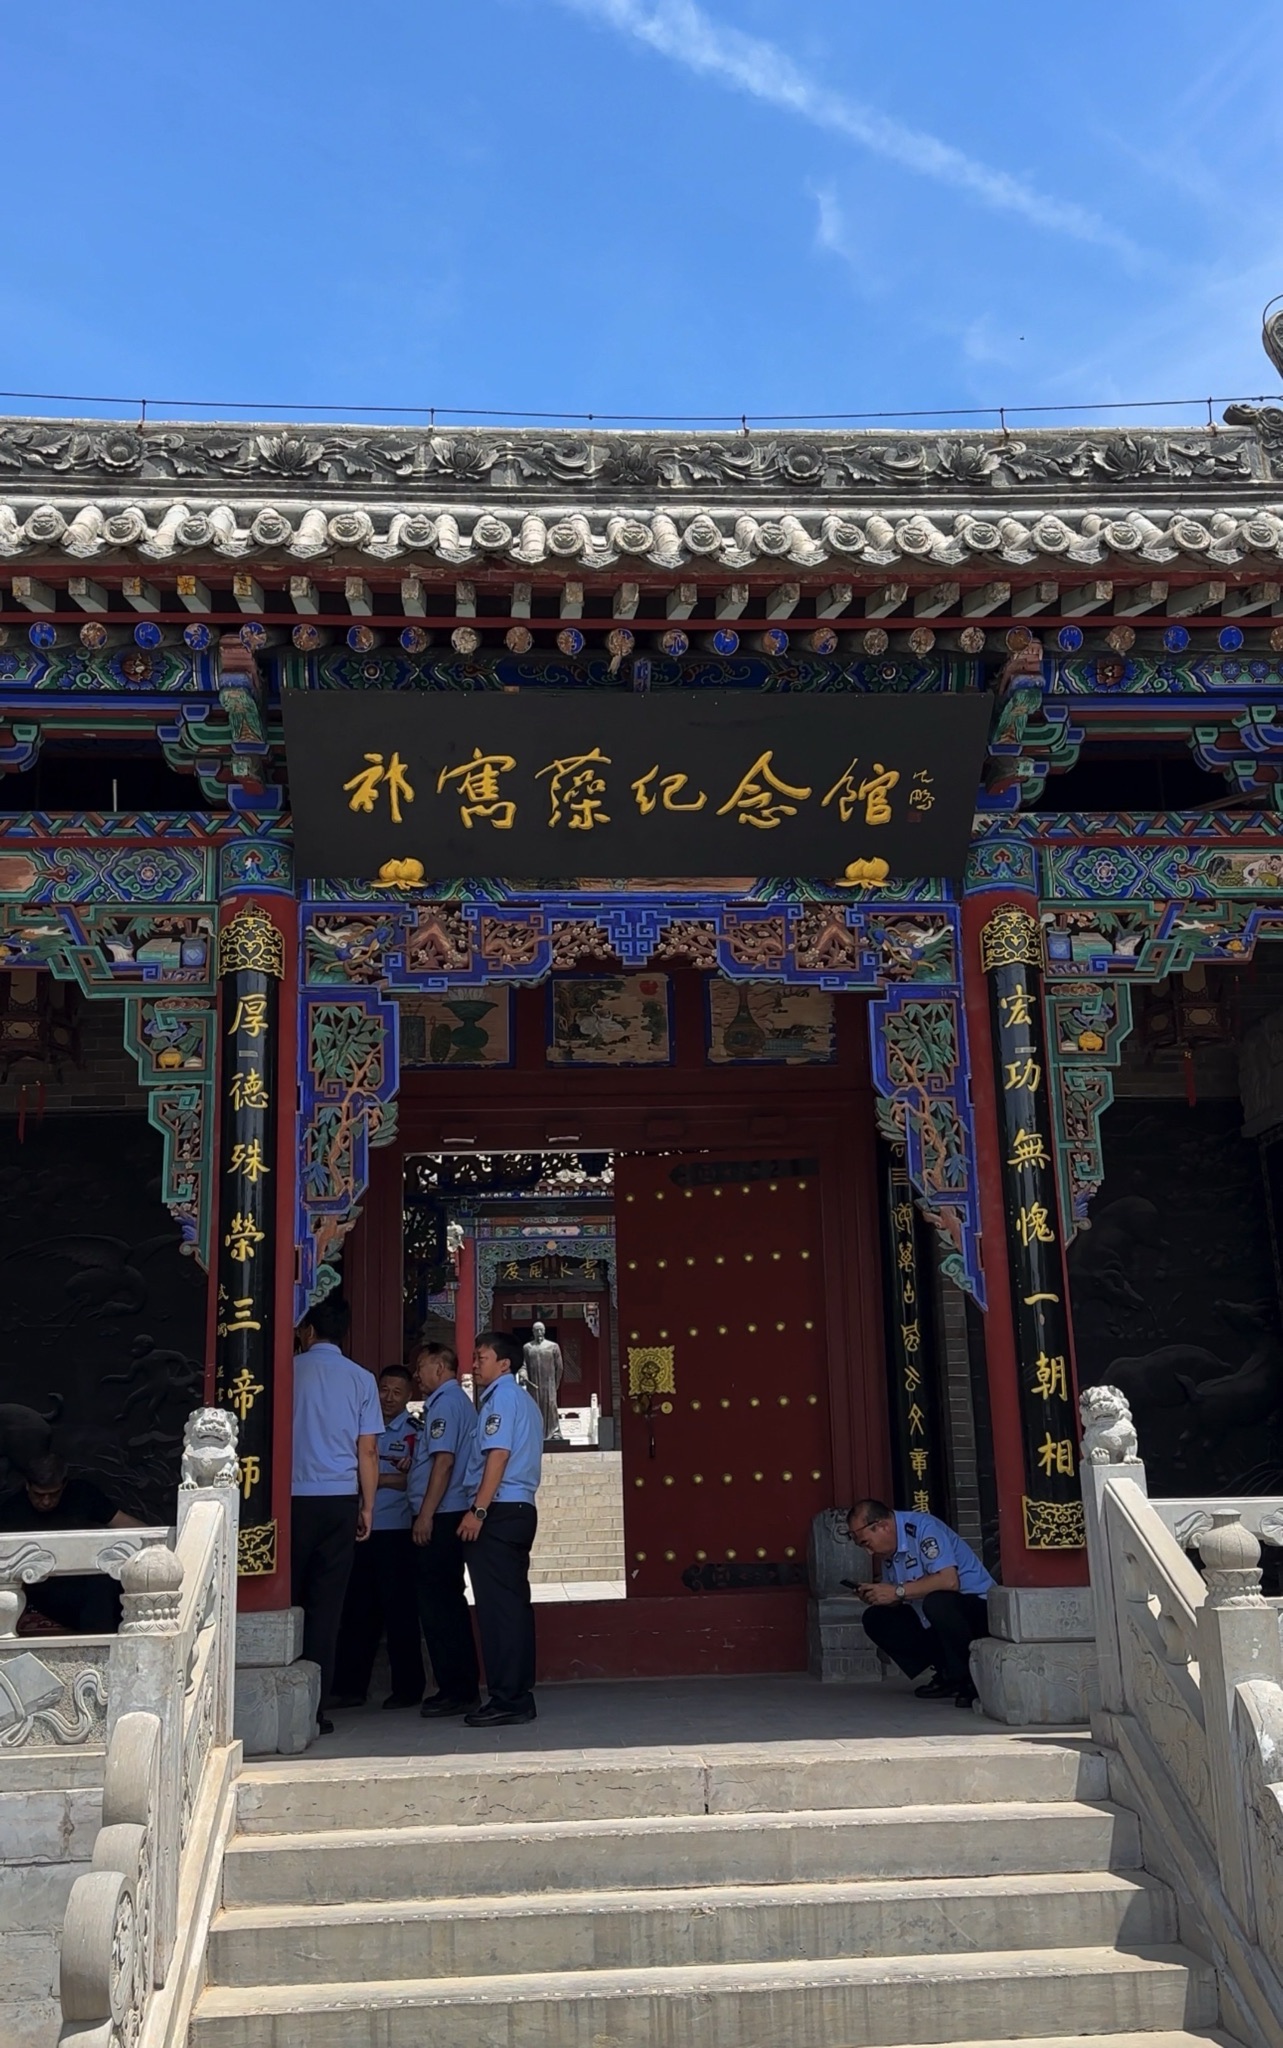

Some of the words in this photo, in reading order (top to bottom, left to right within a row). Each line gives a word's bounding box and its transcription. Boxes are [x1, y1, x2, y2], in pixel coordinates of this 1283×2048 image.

[1001, 984, 1075, 1478] 宏功無愧一朝相
